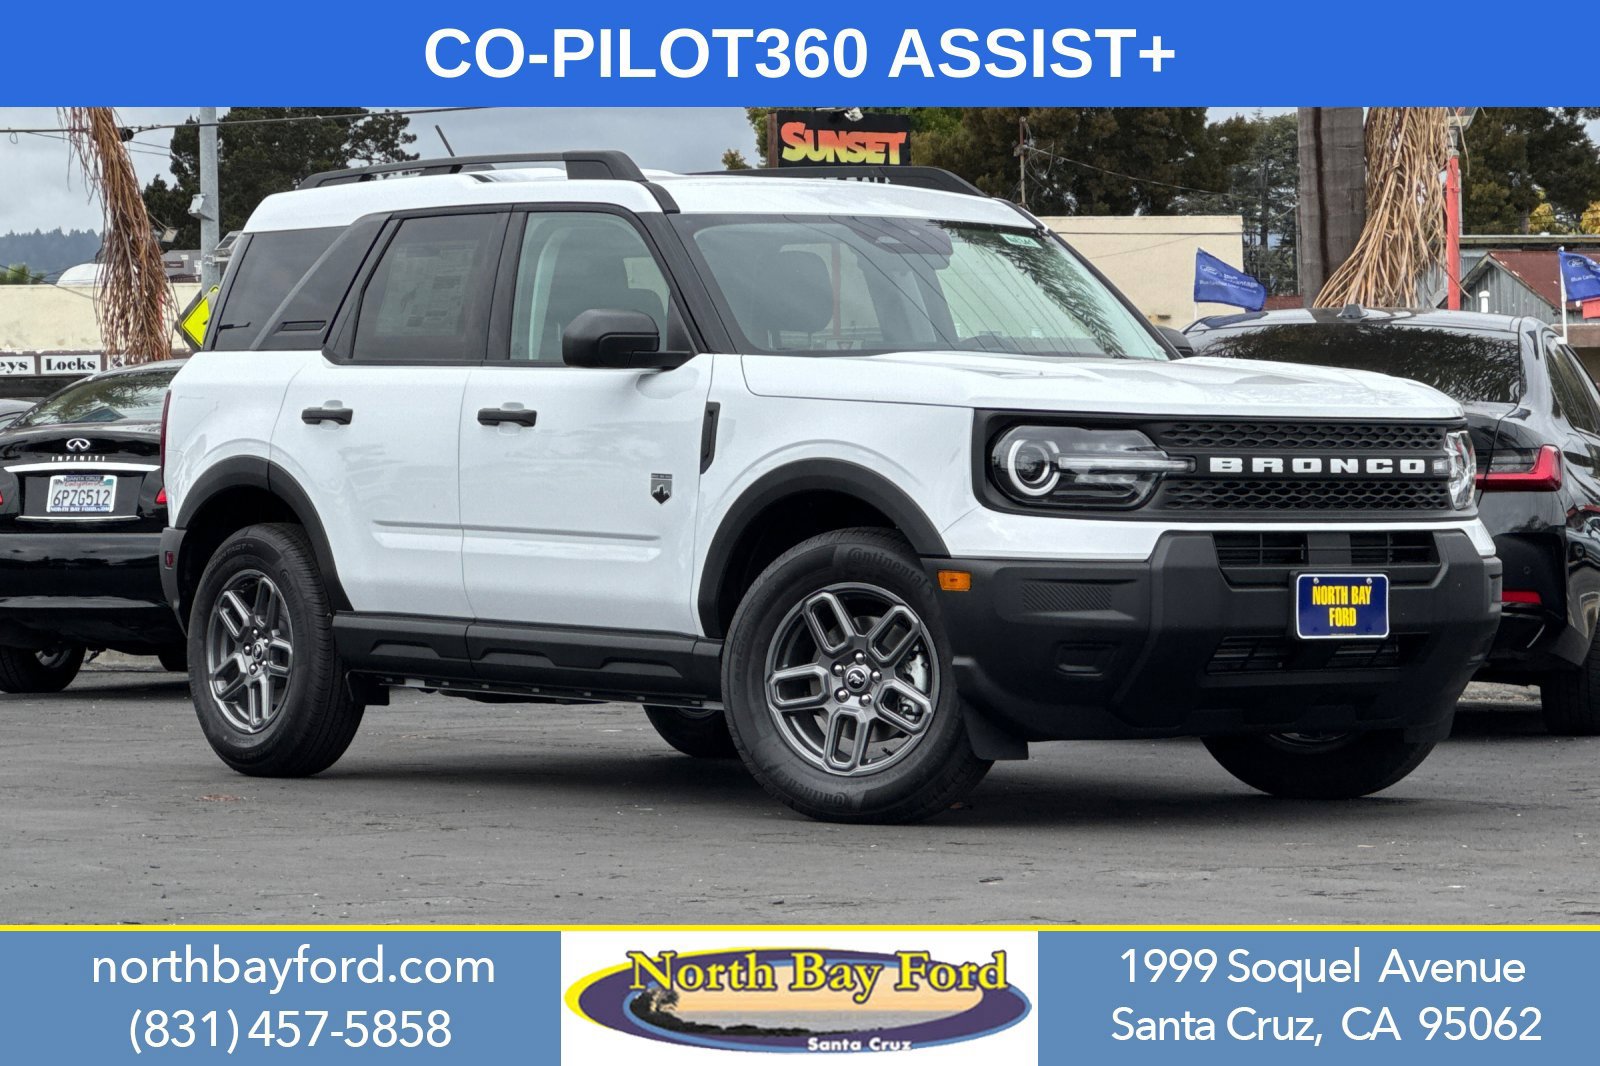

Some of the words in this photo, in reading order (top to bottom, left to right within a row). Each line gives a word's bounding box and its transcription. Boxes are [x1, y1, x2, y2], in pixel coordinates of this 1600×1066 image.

[780, 121, 907, 165] SUNSET
[45, 358, 96, 371] Locks
[1209, 456, 1426, 474] BRONCO
[52, 489, 111, 506] 6PZG512
[1312, 585, 1349, 605] NORTH
[1351, 585, 1372, 605] BAY
[1328, 607, 1357, 627] FORD
